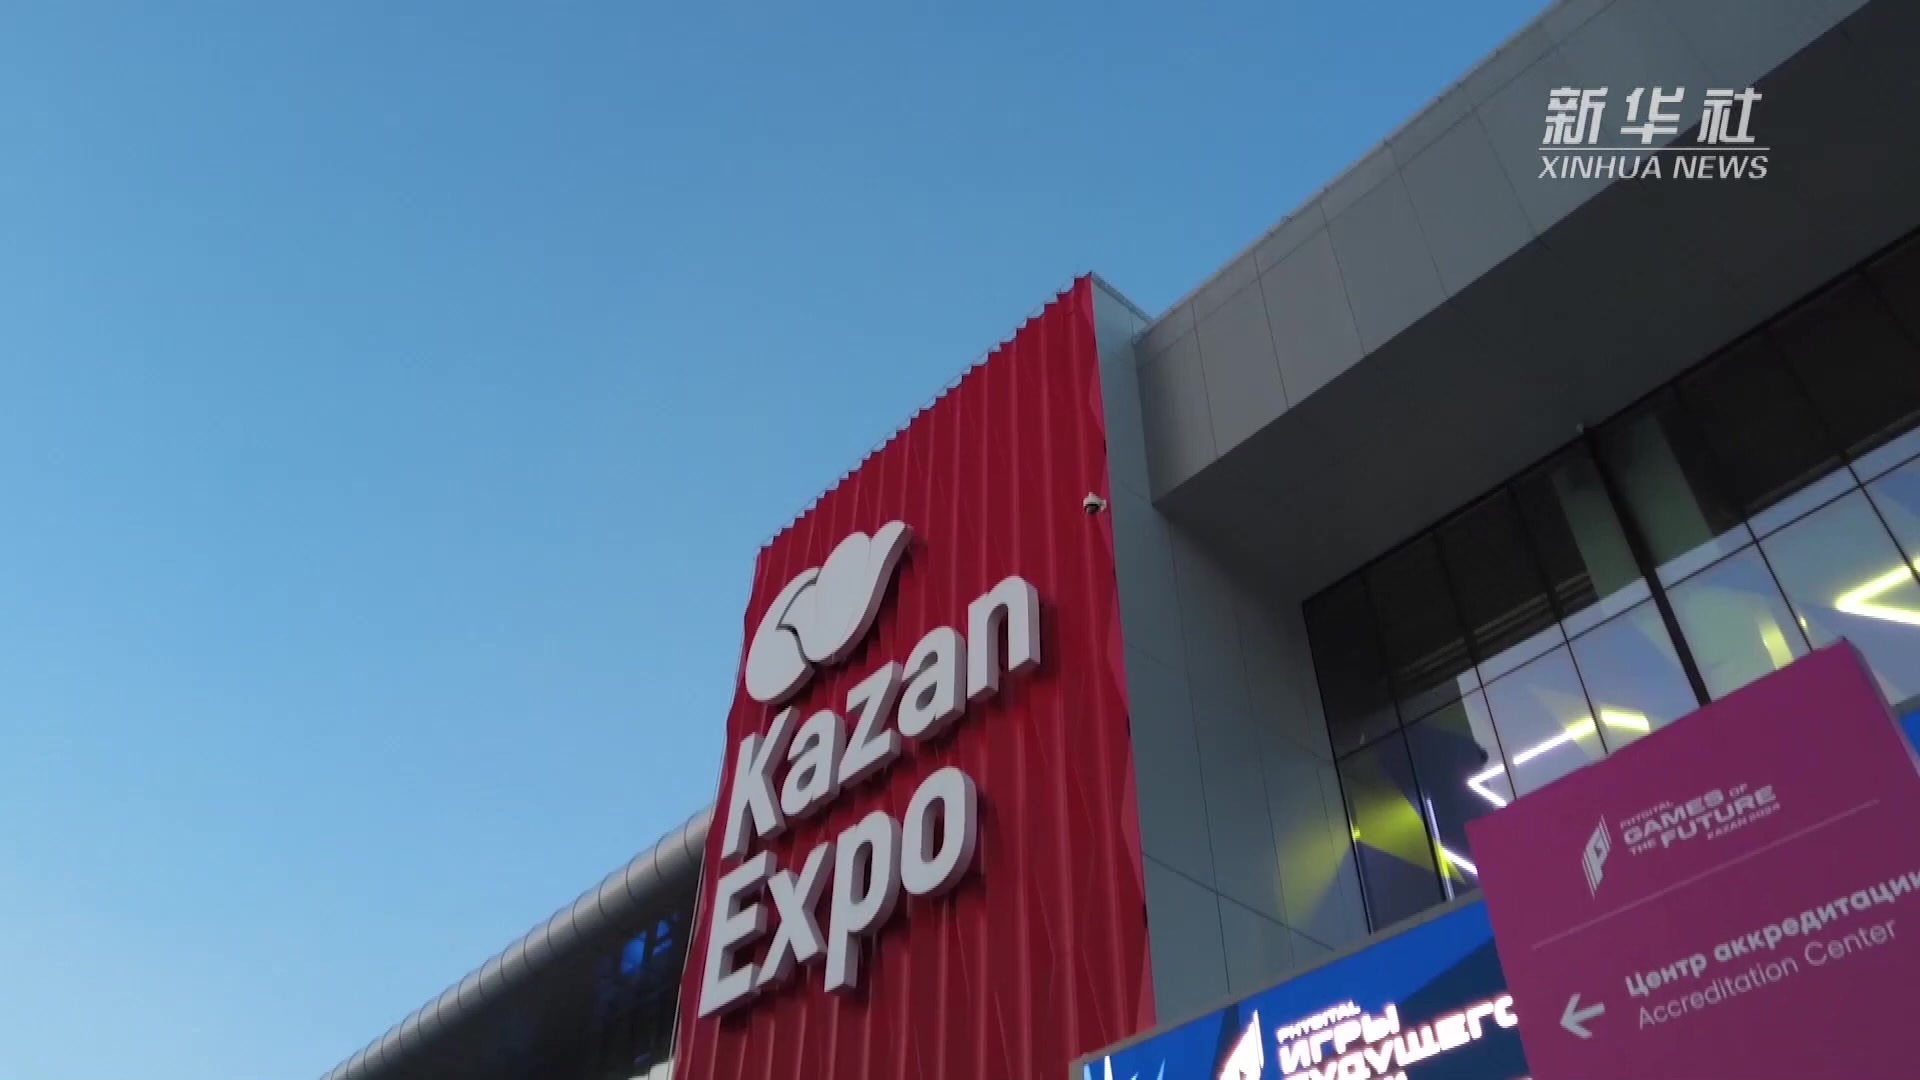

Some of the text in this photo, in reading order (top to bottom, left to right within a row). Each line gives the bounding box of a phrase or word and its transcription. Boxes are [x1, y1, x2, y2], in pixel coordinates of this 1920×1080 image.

[721, 575, 1040, 860] Kazan
[1623, 782, 1748, 846] GAMES OF
[1629, 784, 1777, 856] THE FUTURE
[698, 766, 977, 1018] Expo
[1625, 952, 1707, 998] Центр
[1639, 918, 1896, 1030] Accreditation Center
[1279, 1001, 1400, 1076] ИГРЫ
